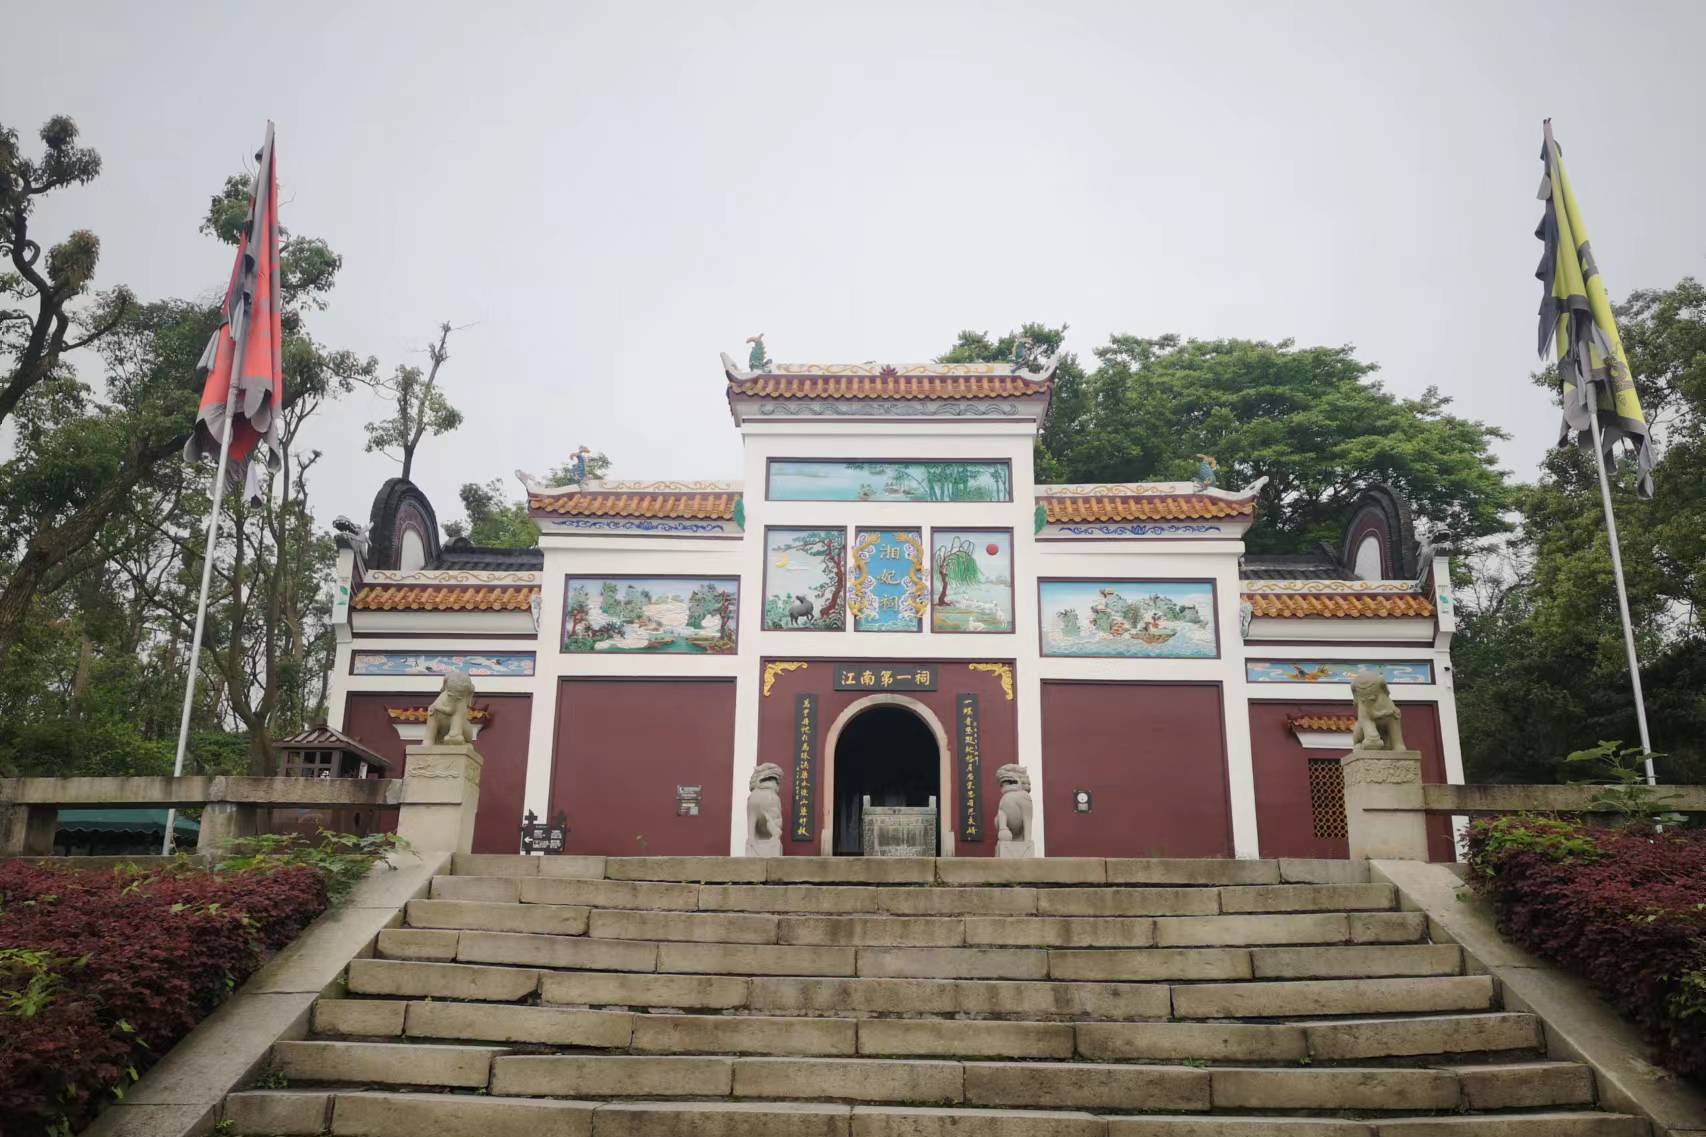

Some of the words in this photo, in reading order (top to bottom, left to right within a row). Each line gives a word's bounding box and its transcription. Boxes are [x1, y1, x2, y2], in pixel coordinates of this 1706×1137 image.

[878, 543, 901, 611] 湘妃祠
[840, 669, 931, 688] 江南第一祠
